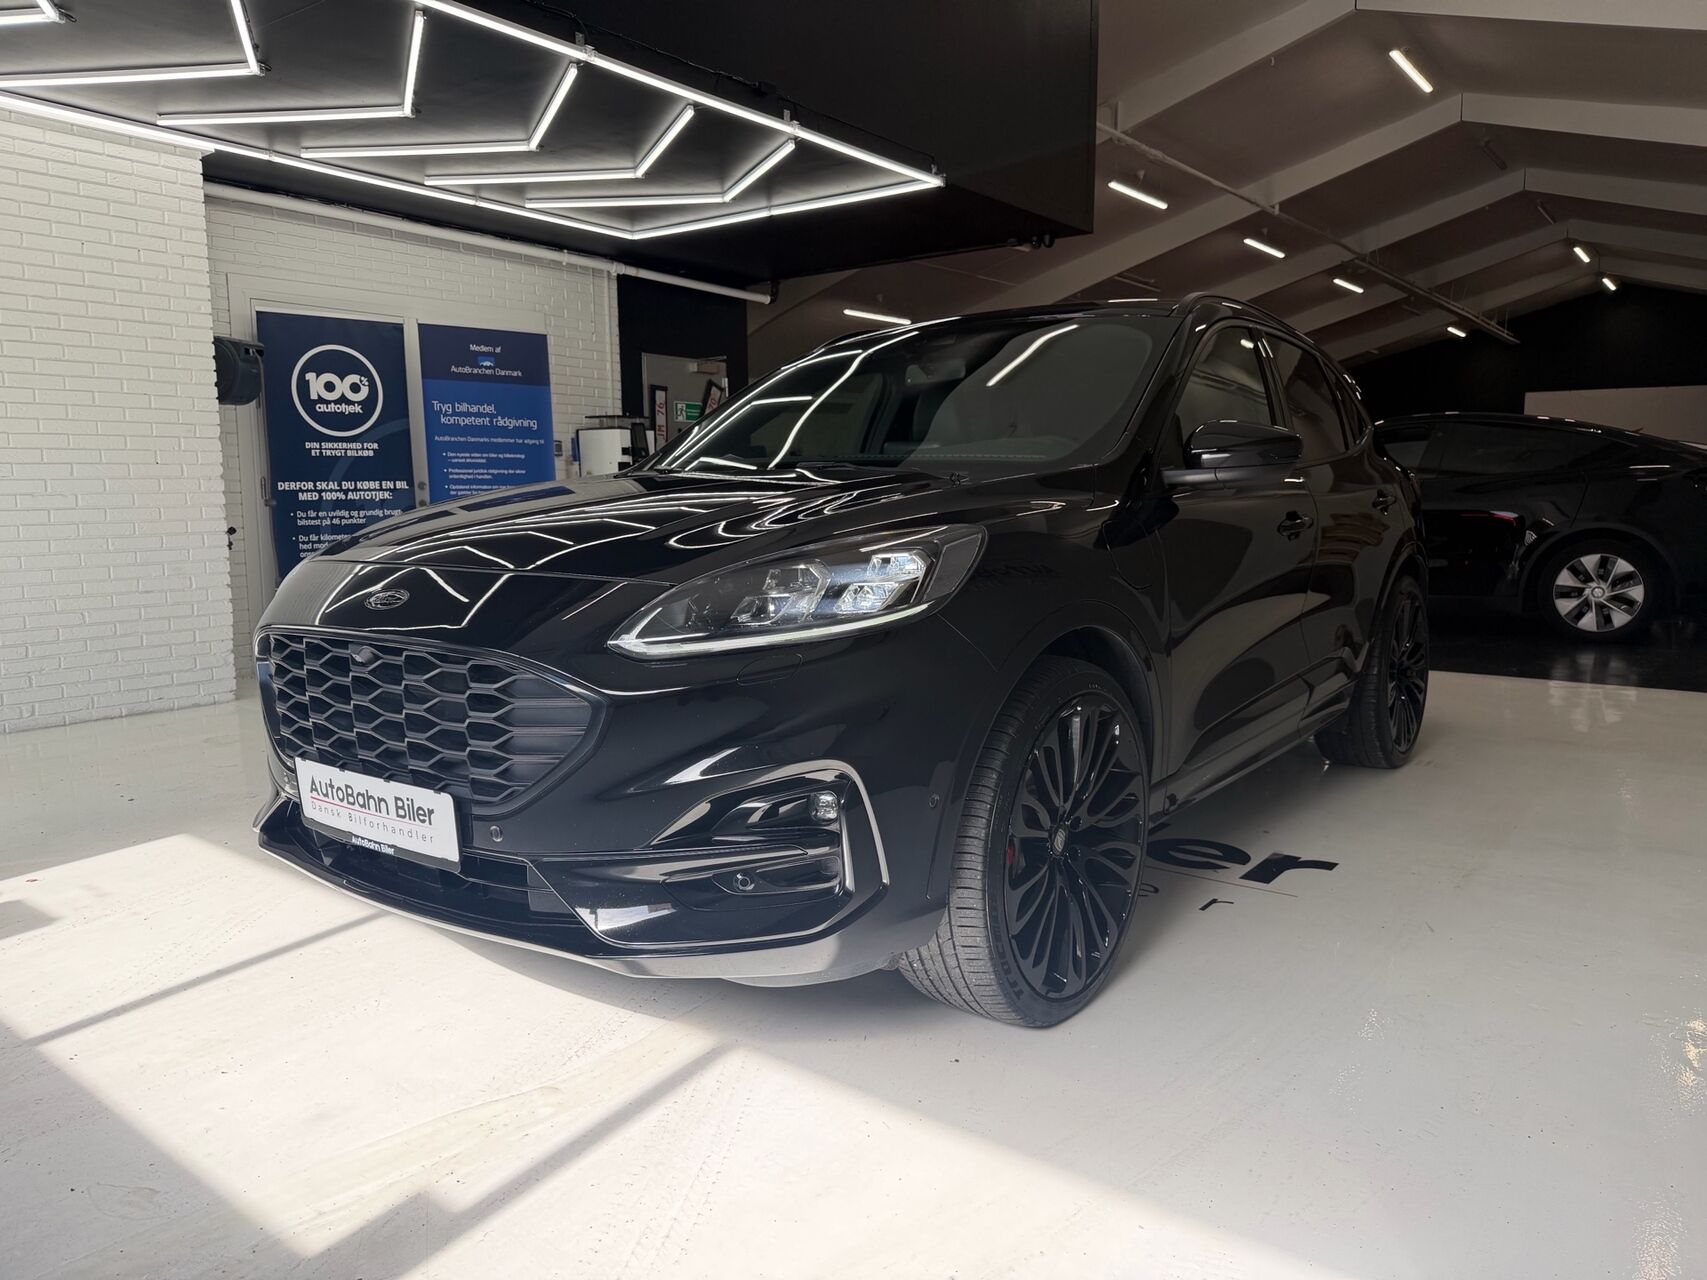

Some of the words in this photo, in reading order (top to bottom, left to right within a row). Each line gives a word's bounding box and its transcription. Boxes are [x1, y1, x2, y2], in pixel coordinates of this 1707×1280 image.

[470, 344, 493, 352] Medlem
[451, 366, 494, 375] AutoBranchen
[496, 368, 522, 376] Danmark
[316, 402, 363, 414] autotjek
[432, 401, 452, 414] Tryg
[455, 402, 496, 414] bilhandel,
[441, 415, 490, 426] kompetent
[494, 416, 538, 430] rådgivning
[278, 482, 314, 490] DERFOR
[316, 482, 340, 490] SKAL
[342, 481, 355, 489] DU
[357, 481, 380, 489] KØBE
[382, 481, 394, 489] EN
[396, 481, 408, 489] BIL
[298, 492, 319, 500] MED
[321, 492, 345, 500] 100%
[347, 491, 393, 501] AUTOTJEK:
[322, 518, 331, 526] på
[341, 517, 366, 526] punkter
[310, 776, 389, 816] AutoBahn
[394, 796, 434, 826] Biler
[311, 801, 341, 818] Dansk
[348, 812, 434, 843] Bilforhandler
[352, 836, 380, 851] AutoBahn
[380, 844, 395, 855] Biler
